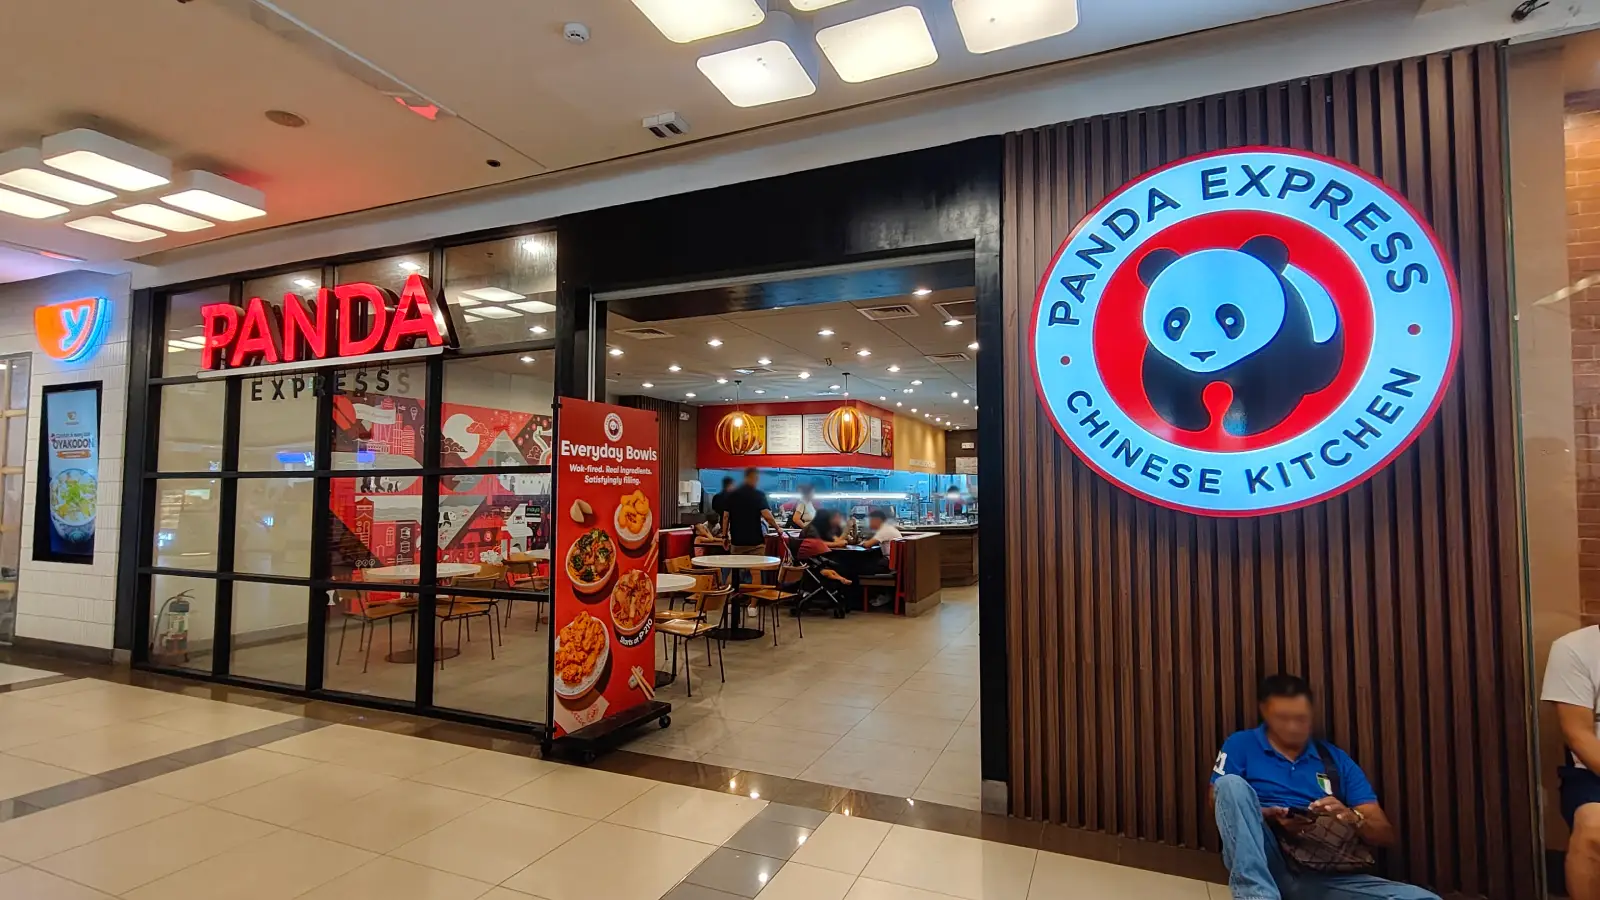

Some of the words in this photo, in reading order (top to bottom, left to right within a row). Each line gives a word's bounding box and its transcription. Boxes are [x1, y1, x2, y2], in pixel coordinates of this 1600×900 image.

[1048, 187, 1180, 327] PANDA
[1201, 164, 1429, 293] EXPRESS
[201, 272, 443, 370] PANDA
[251, 369, 390, 401] EXPRESS
[1067, 390, 1222, 495] CHINESE
[1245, 367, 1421, 495] KITCHEN
[561, 440, 623, 462] Everyday
[626, 446, 657, 461] Bowls
[569, 464, 604, 473] Wok-fired.
[606, 466, 619, 474] Real
[584, 475, 622, 485] Satisfyingly
